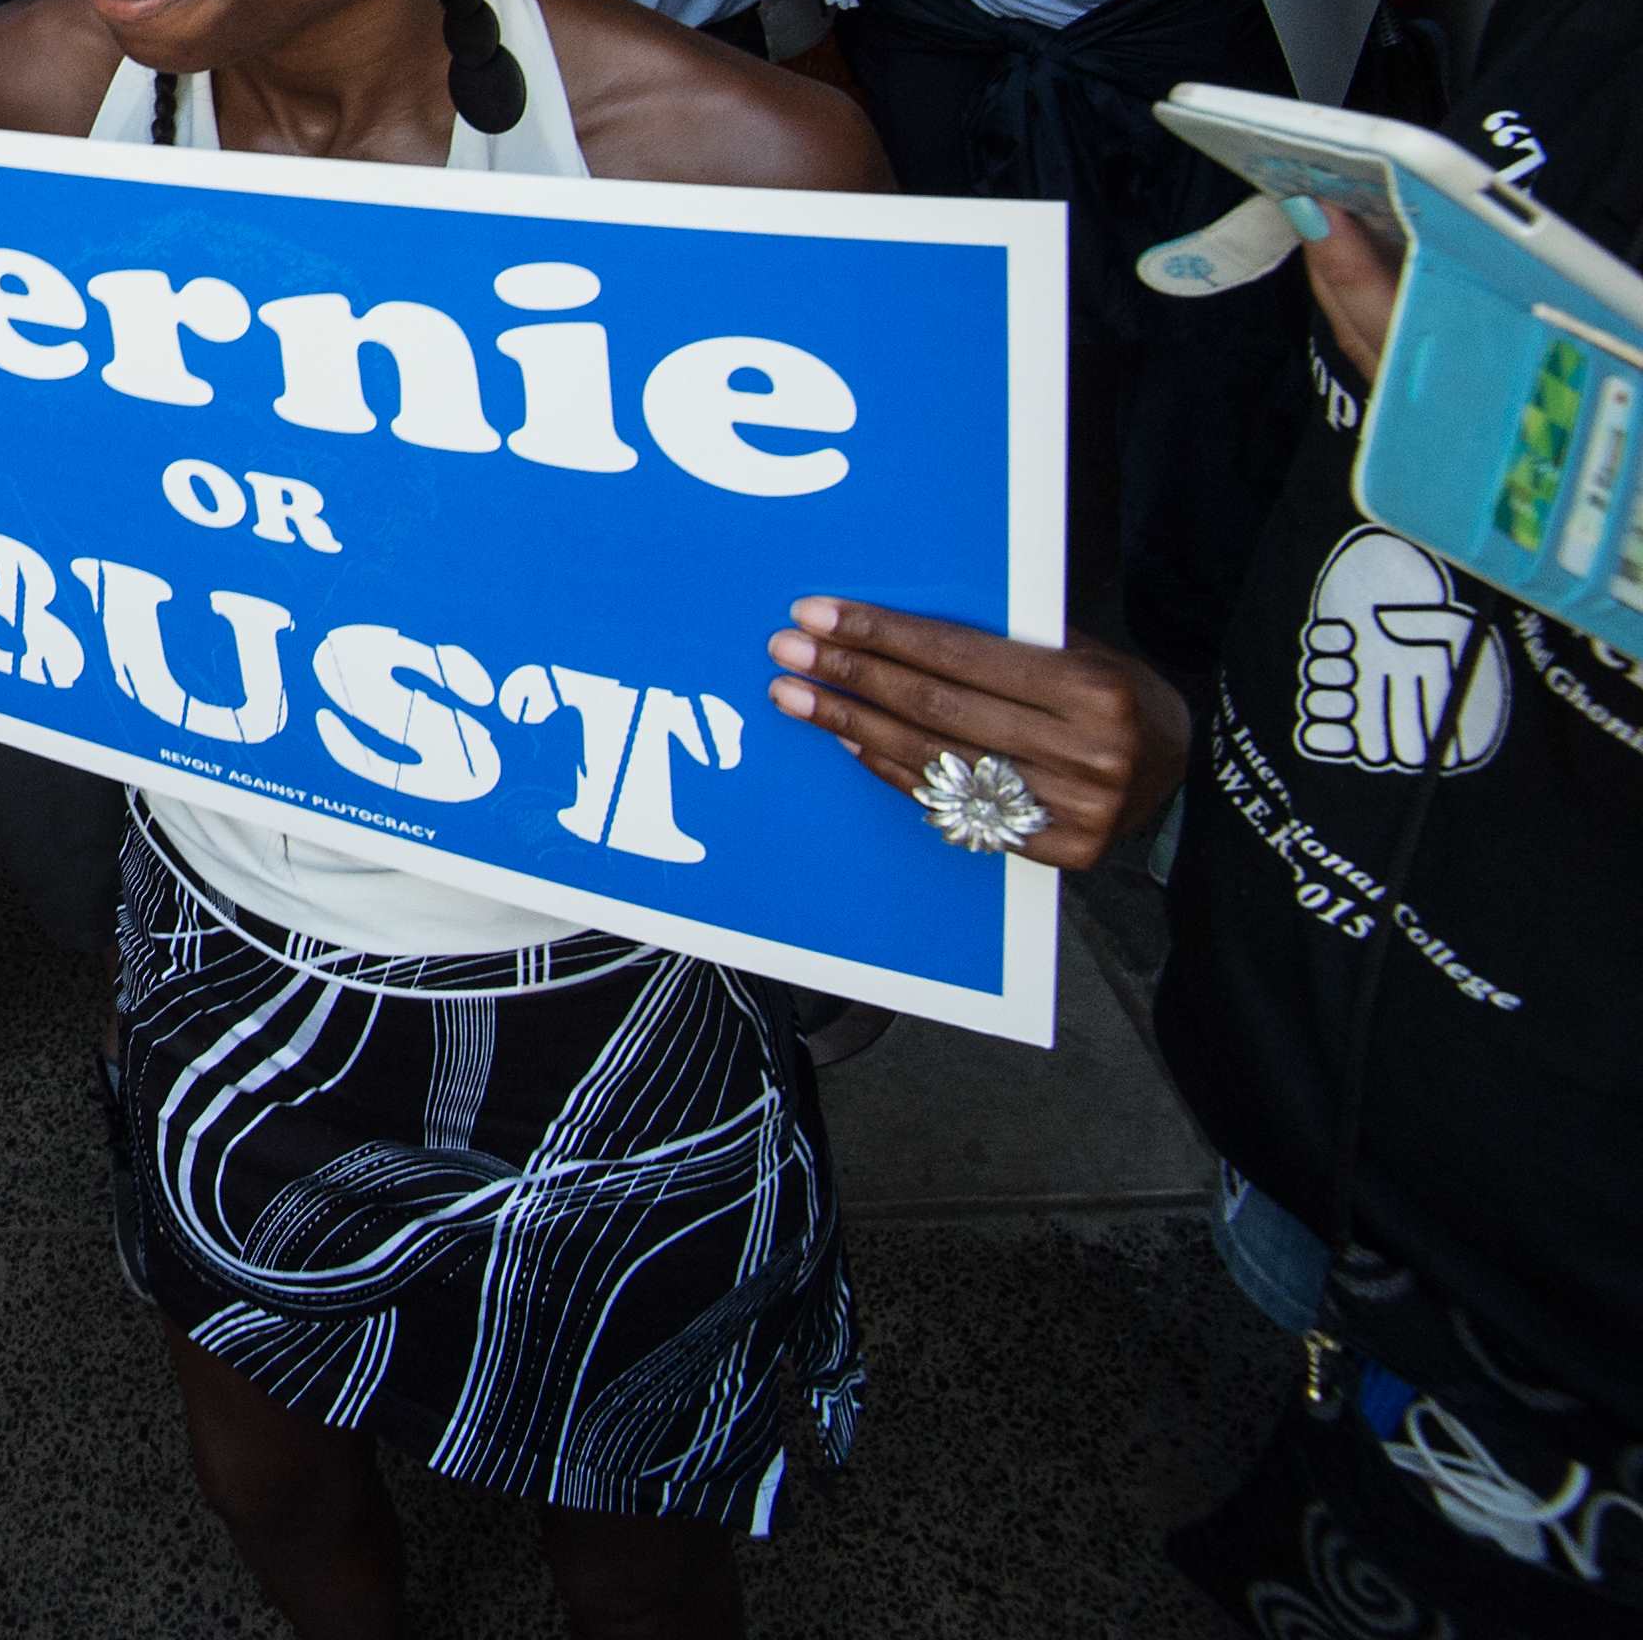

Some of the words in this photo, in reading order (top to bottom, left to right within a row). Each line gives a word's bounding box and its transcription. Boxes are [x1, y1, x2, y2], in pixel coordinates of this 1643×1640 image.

[162, 457, 343, 556] OR
[159, 748, 223, 777] REVOLT
[228, 769, 307, 803] AGAINST
[311, 794, 437, 841] PLUTOCRACY
[1393, 902, 1522, 1011] College
